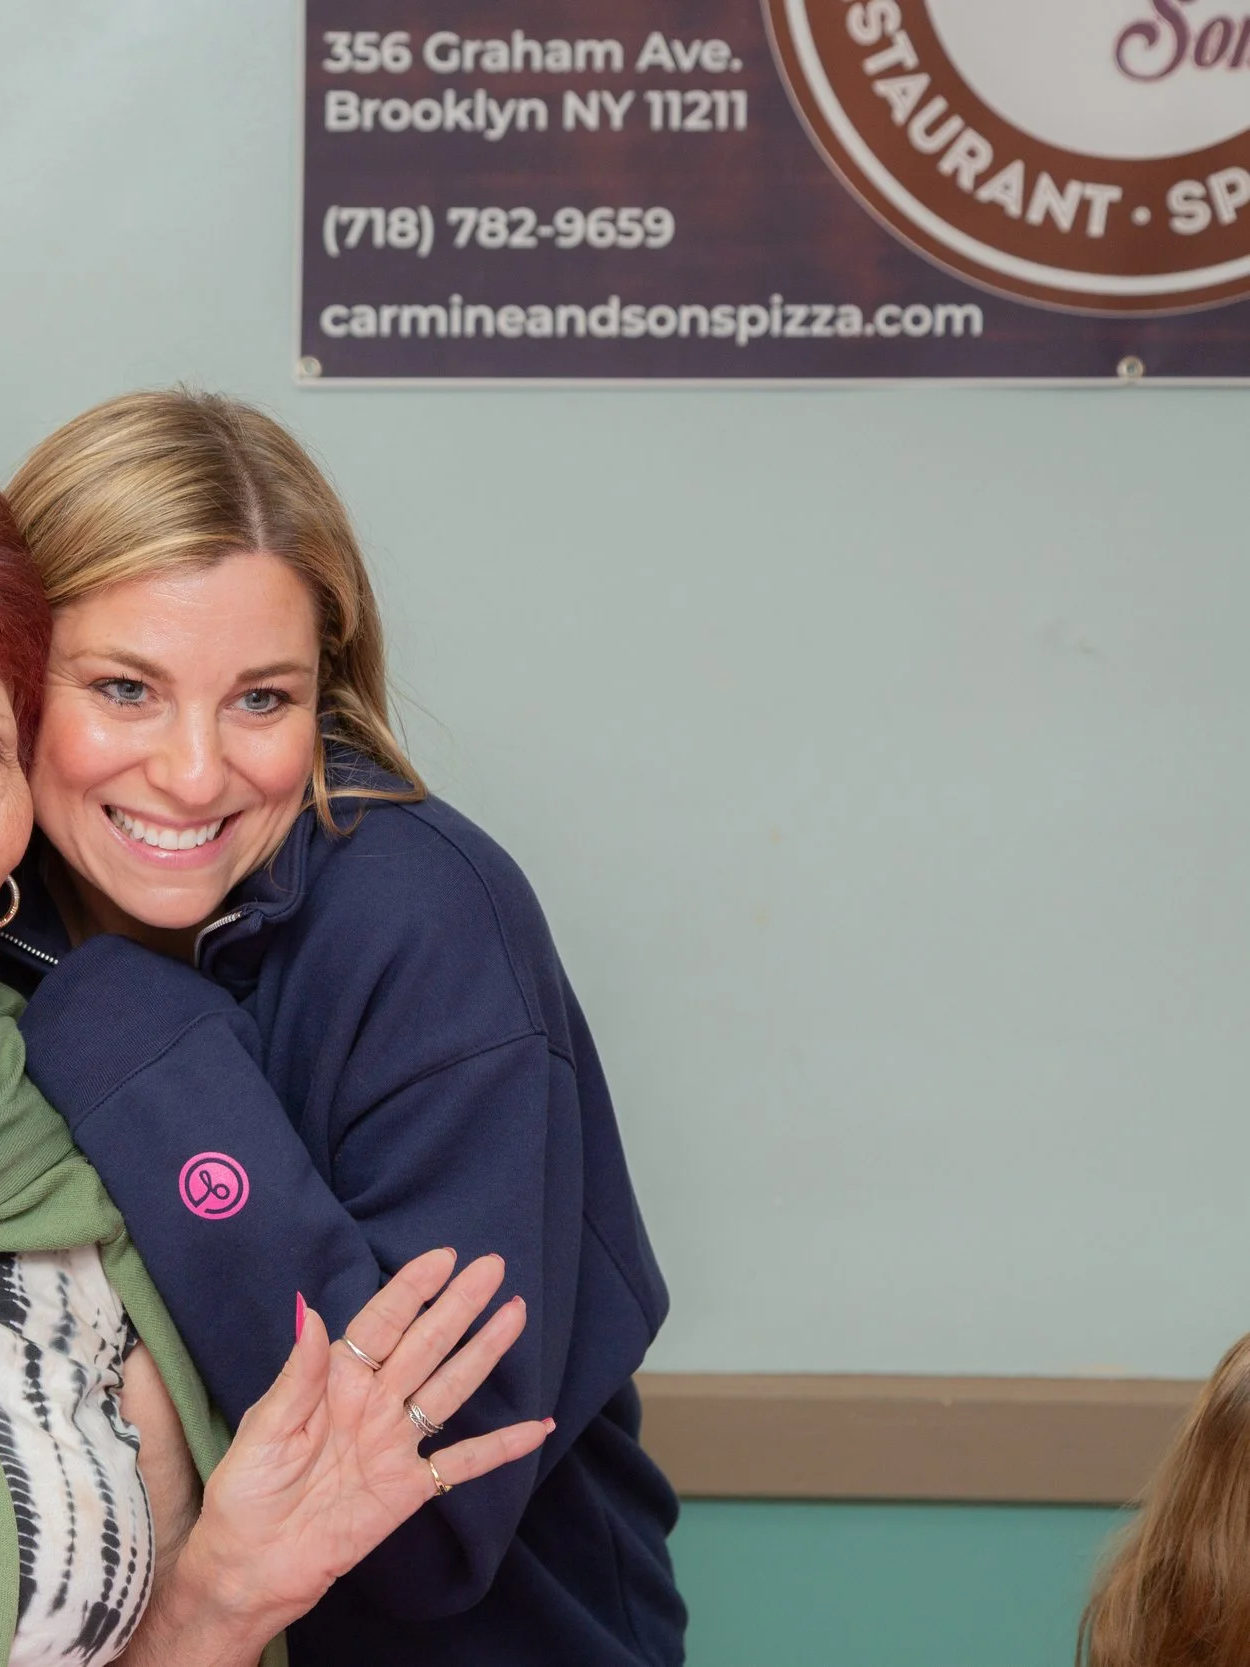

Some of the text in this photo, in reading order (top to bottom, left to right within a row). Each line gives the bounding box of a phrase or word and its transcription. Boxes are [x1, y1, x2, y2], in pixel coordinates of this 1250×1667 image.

[322, 29, 744, 74] 356 Graham Ave.
[324, 88, 748, 141] Brooklyn NY 11211
[845, 0, 1250, 239] STAURANT SP
[322, 205, 676, 258] (718) 782-9659
[320, 293, 983, 347] carmineandsonspizza.com
